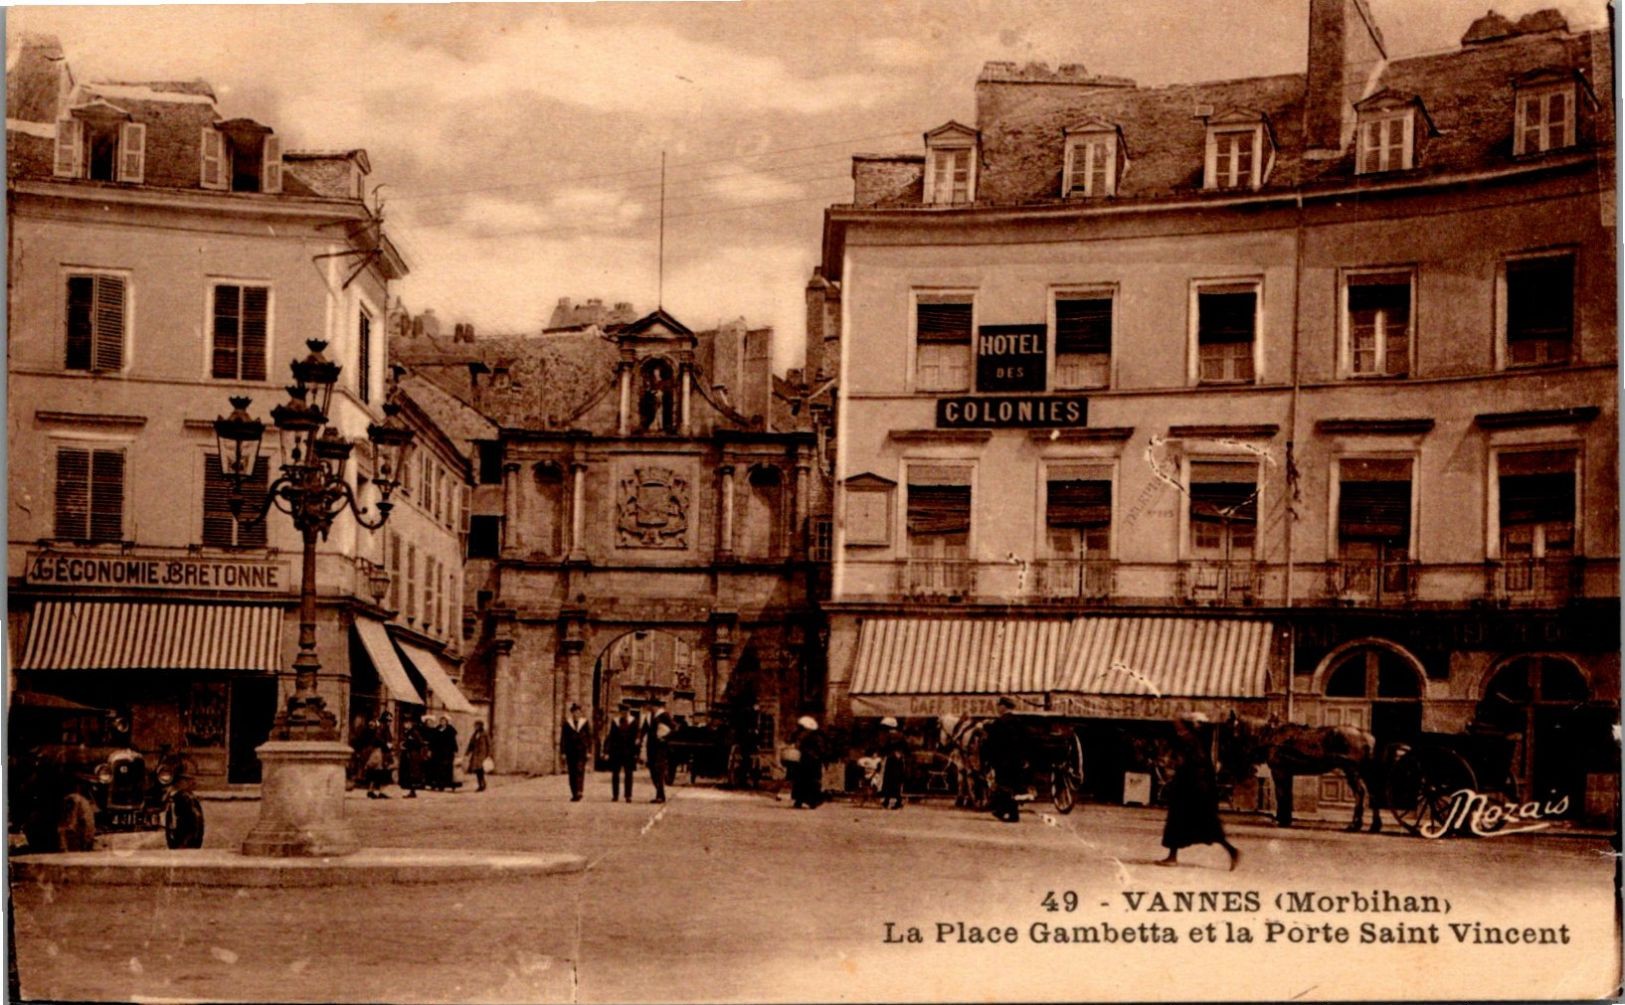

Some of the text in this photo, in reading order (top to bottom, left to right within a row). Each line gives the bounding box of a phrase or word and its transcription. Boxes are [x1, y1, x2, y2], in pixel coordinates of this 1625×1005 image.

[980, 333, 1044, 356] HOTEL
[996, 367, 1024, 378] DES
[945, 402, 1080, 422] COLONIES
[162, 562, 279, 588] BRETONNE
